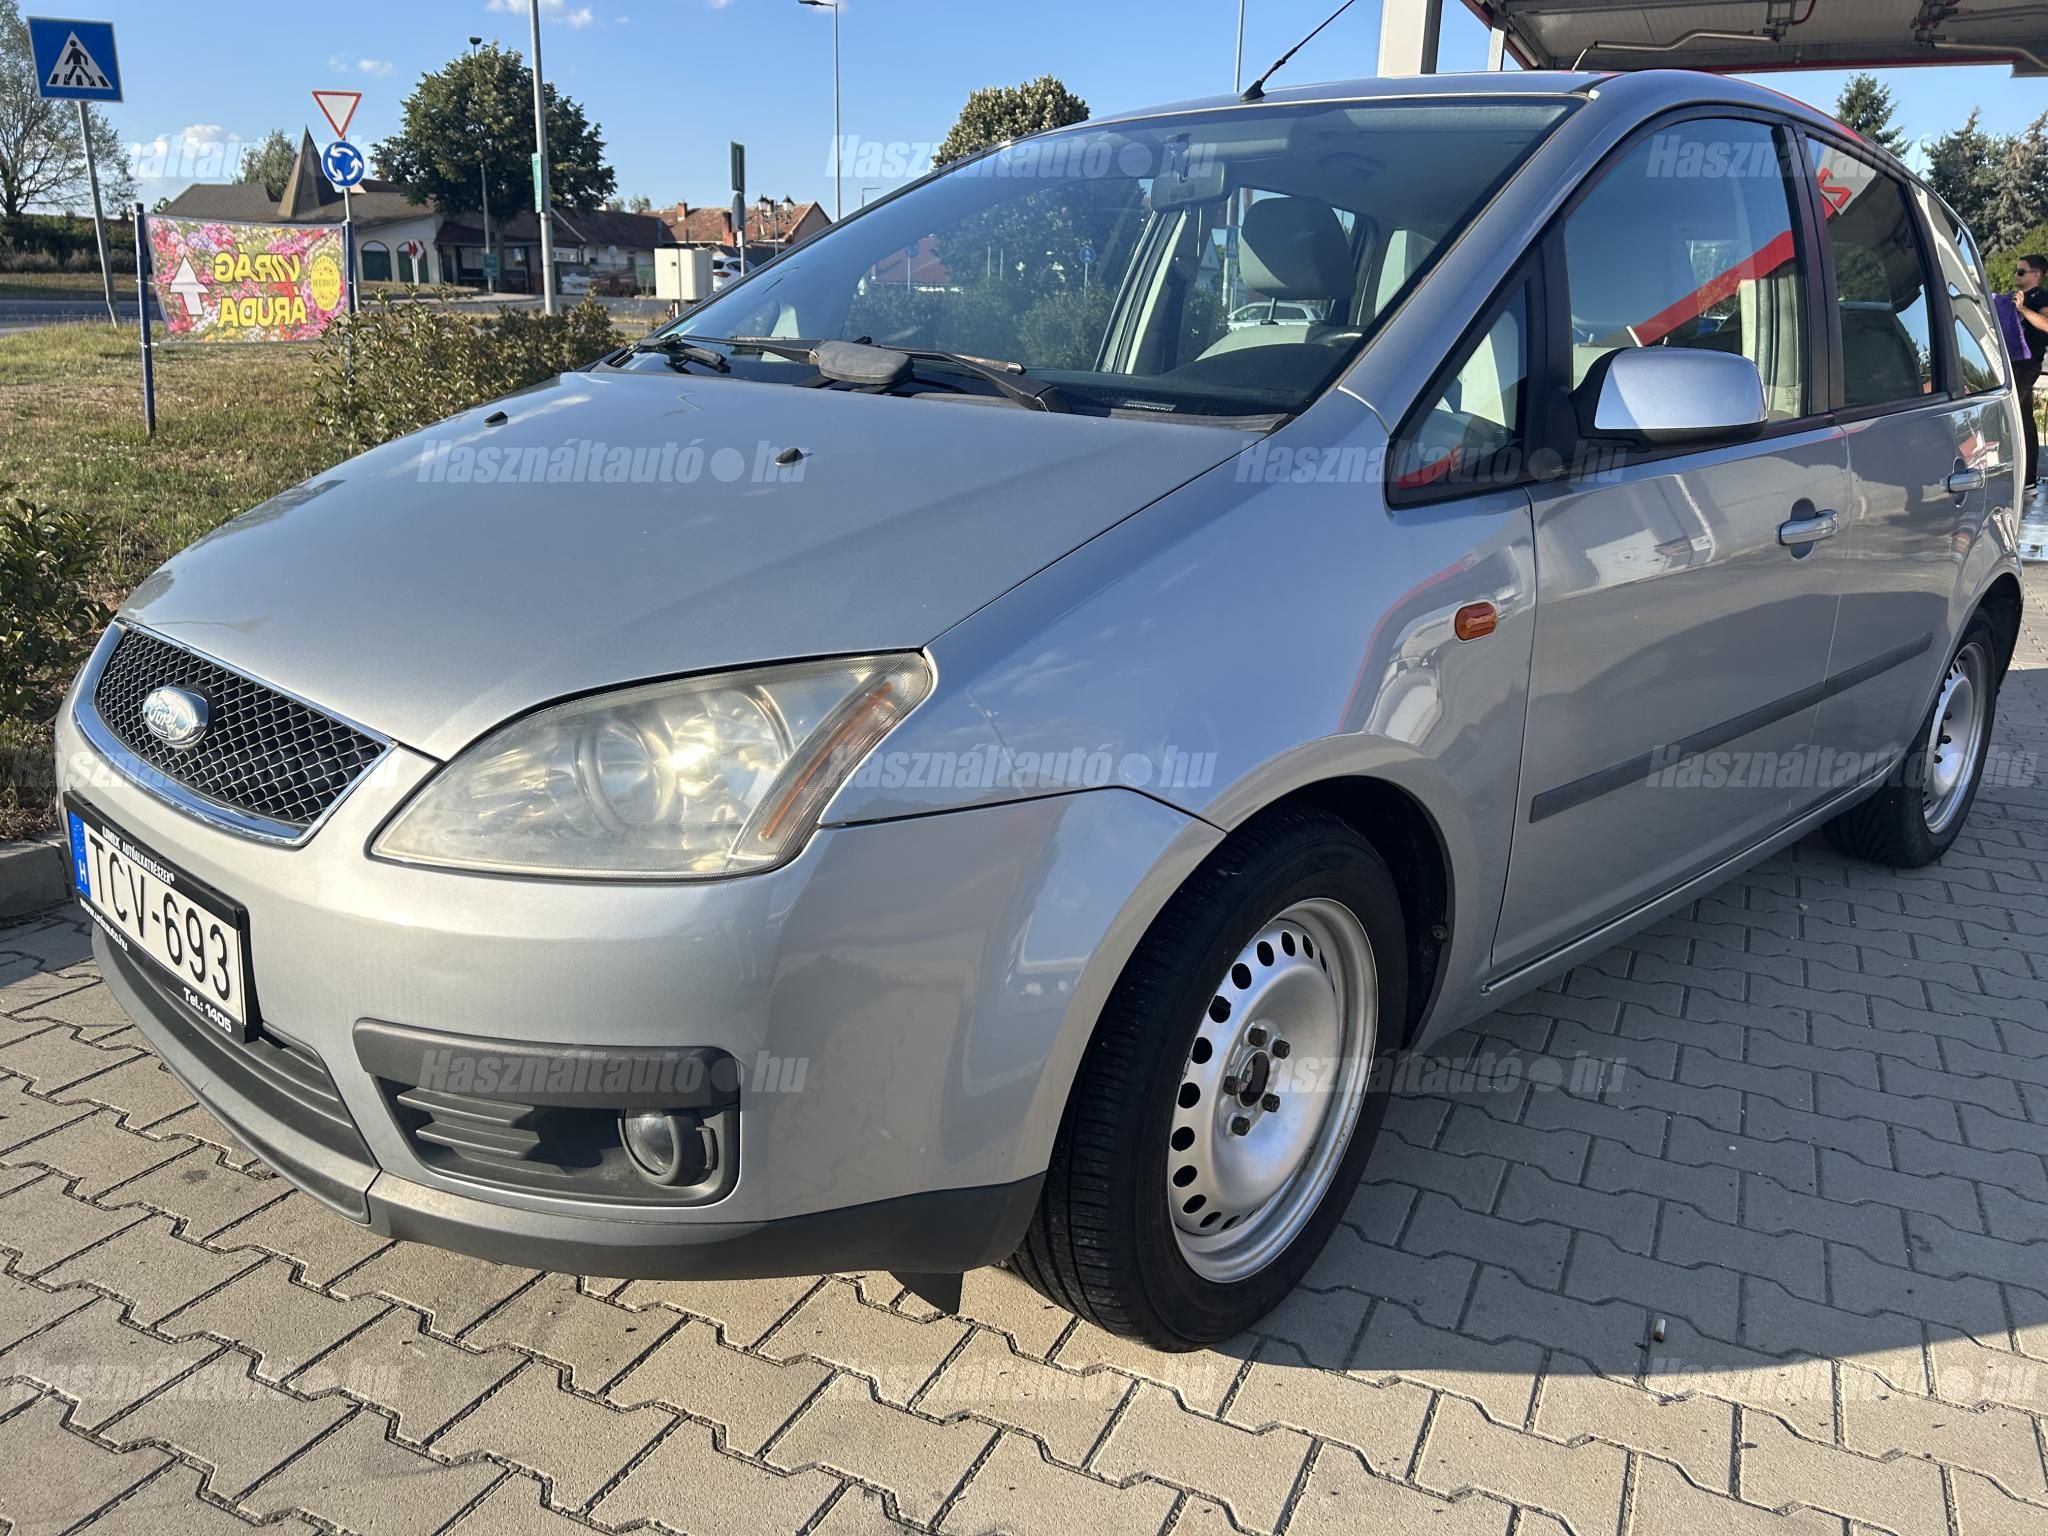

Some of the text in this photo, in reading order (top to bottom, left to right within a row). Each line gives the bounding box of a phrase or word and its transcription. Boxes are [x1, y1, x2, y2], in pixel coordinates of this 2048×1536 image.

[78, 858, 88, 885] H
[88, 833, 231, 1001] TCV-693
[205, 1003, 232, 1033] 1405
